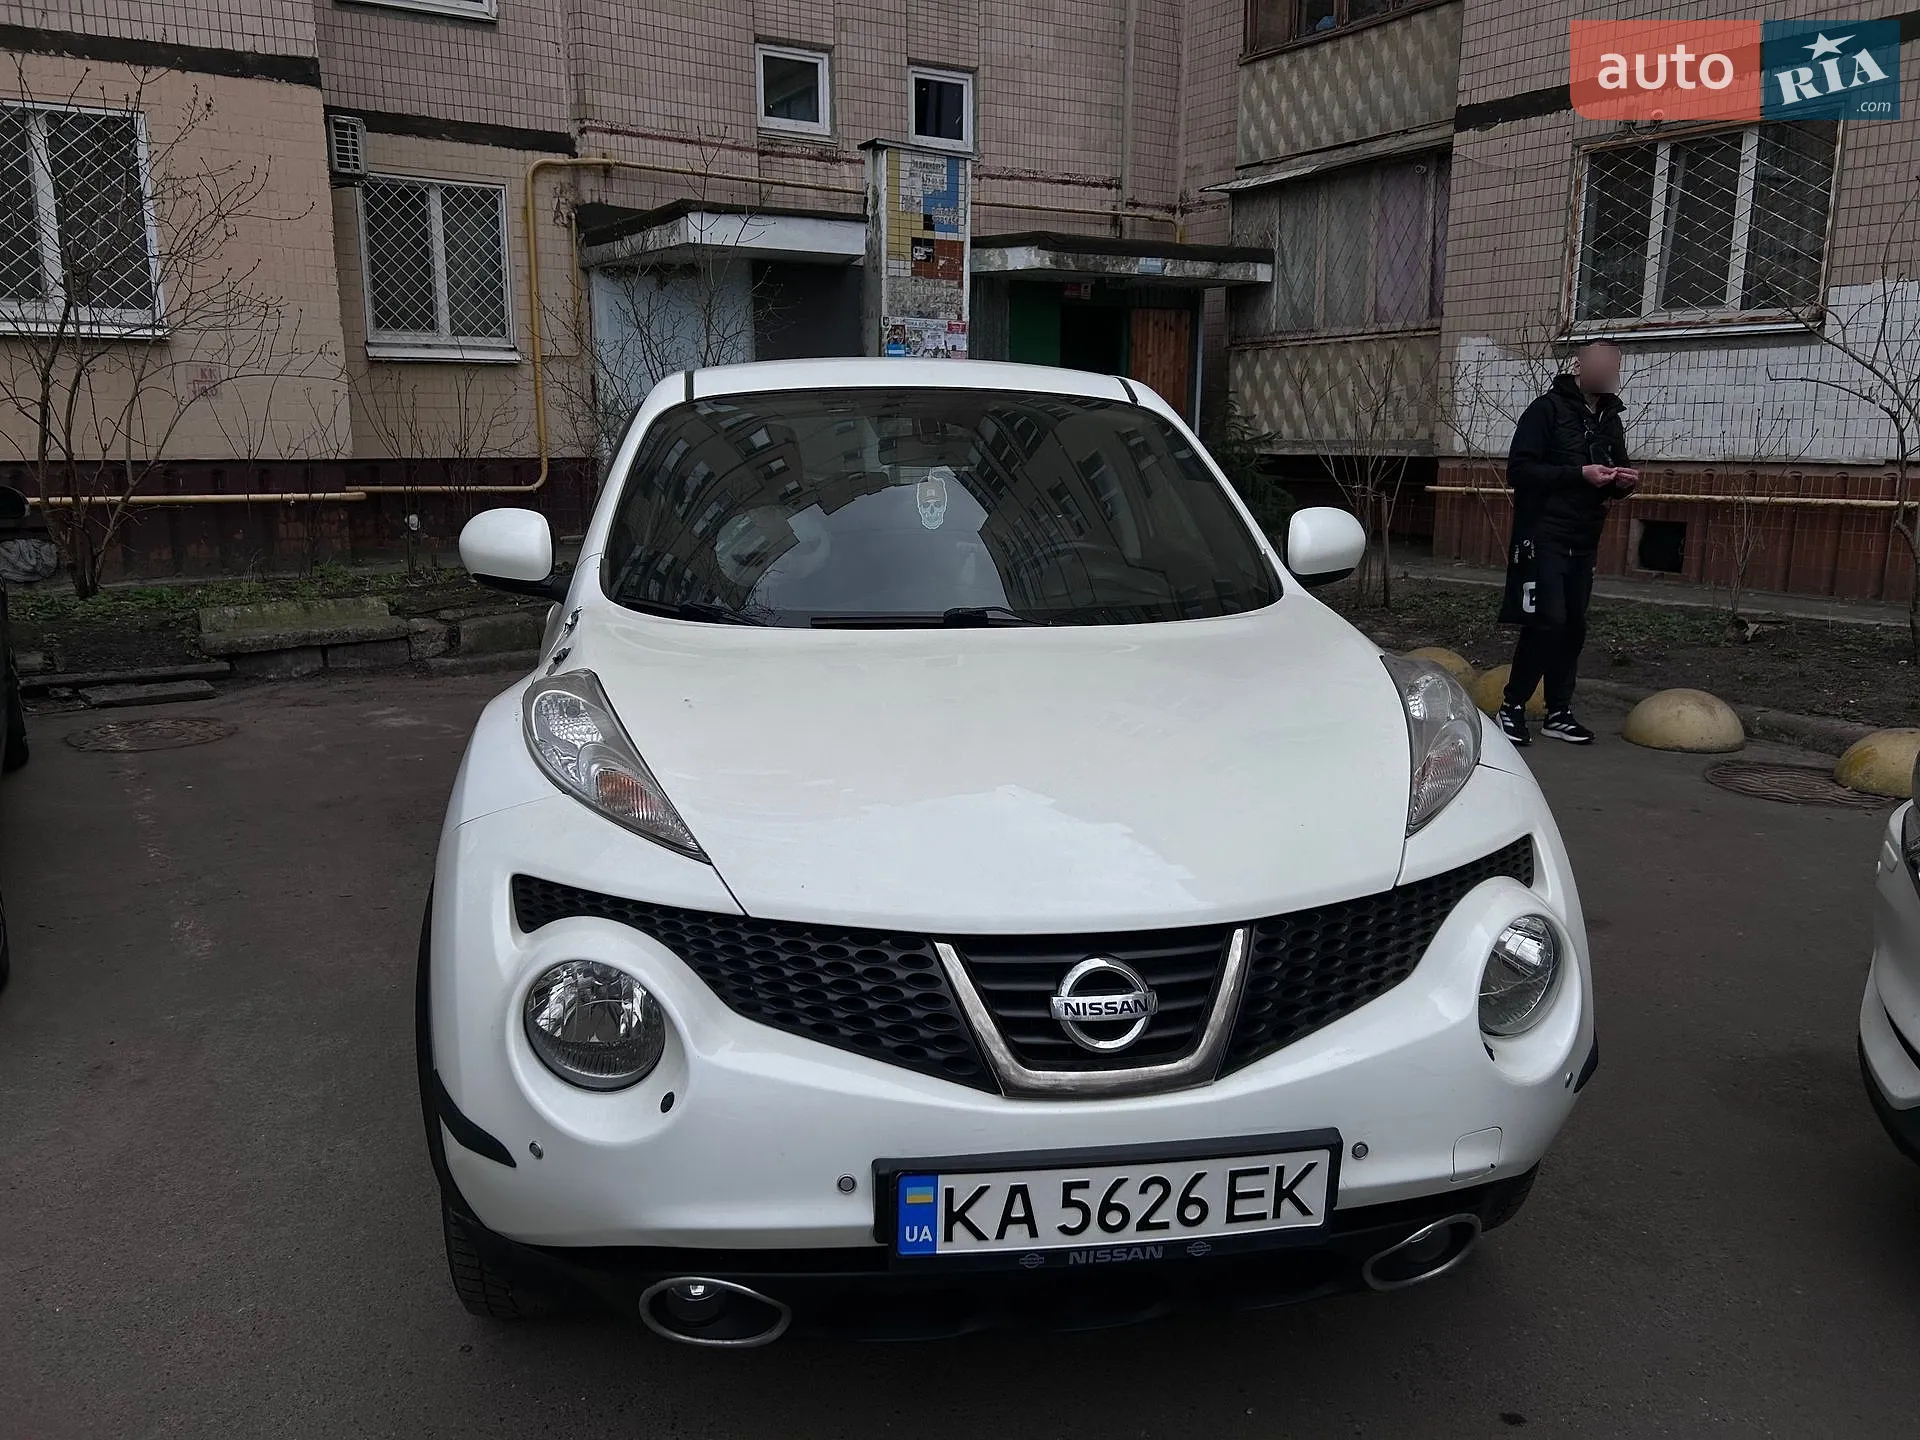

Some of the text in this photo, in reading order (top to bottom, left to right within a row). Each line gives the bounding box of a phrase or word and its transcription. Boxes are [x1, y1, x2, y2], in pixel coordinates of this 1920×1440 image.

[1063, 999, 1149, 1016] NISSAN
[942, 1160, 1319, 1243] KA 5626 EK
[905, 1226, 933, 1243] UA
[1068, 1245, 1164, 1266] NISSAN
